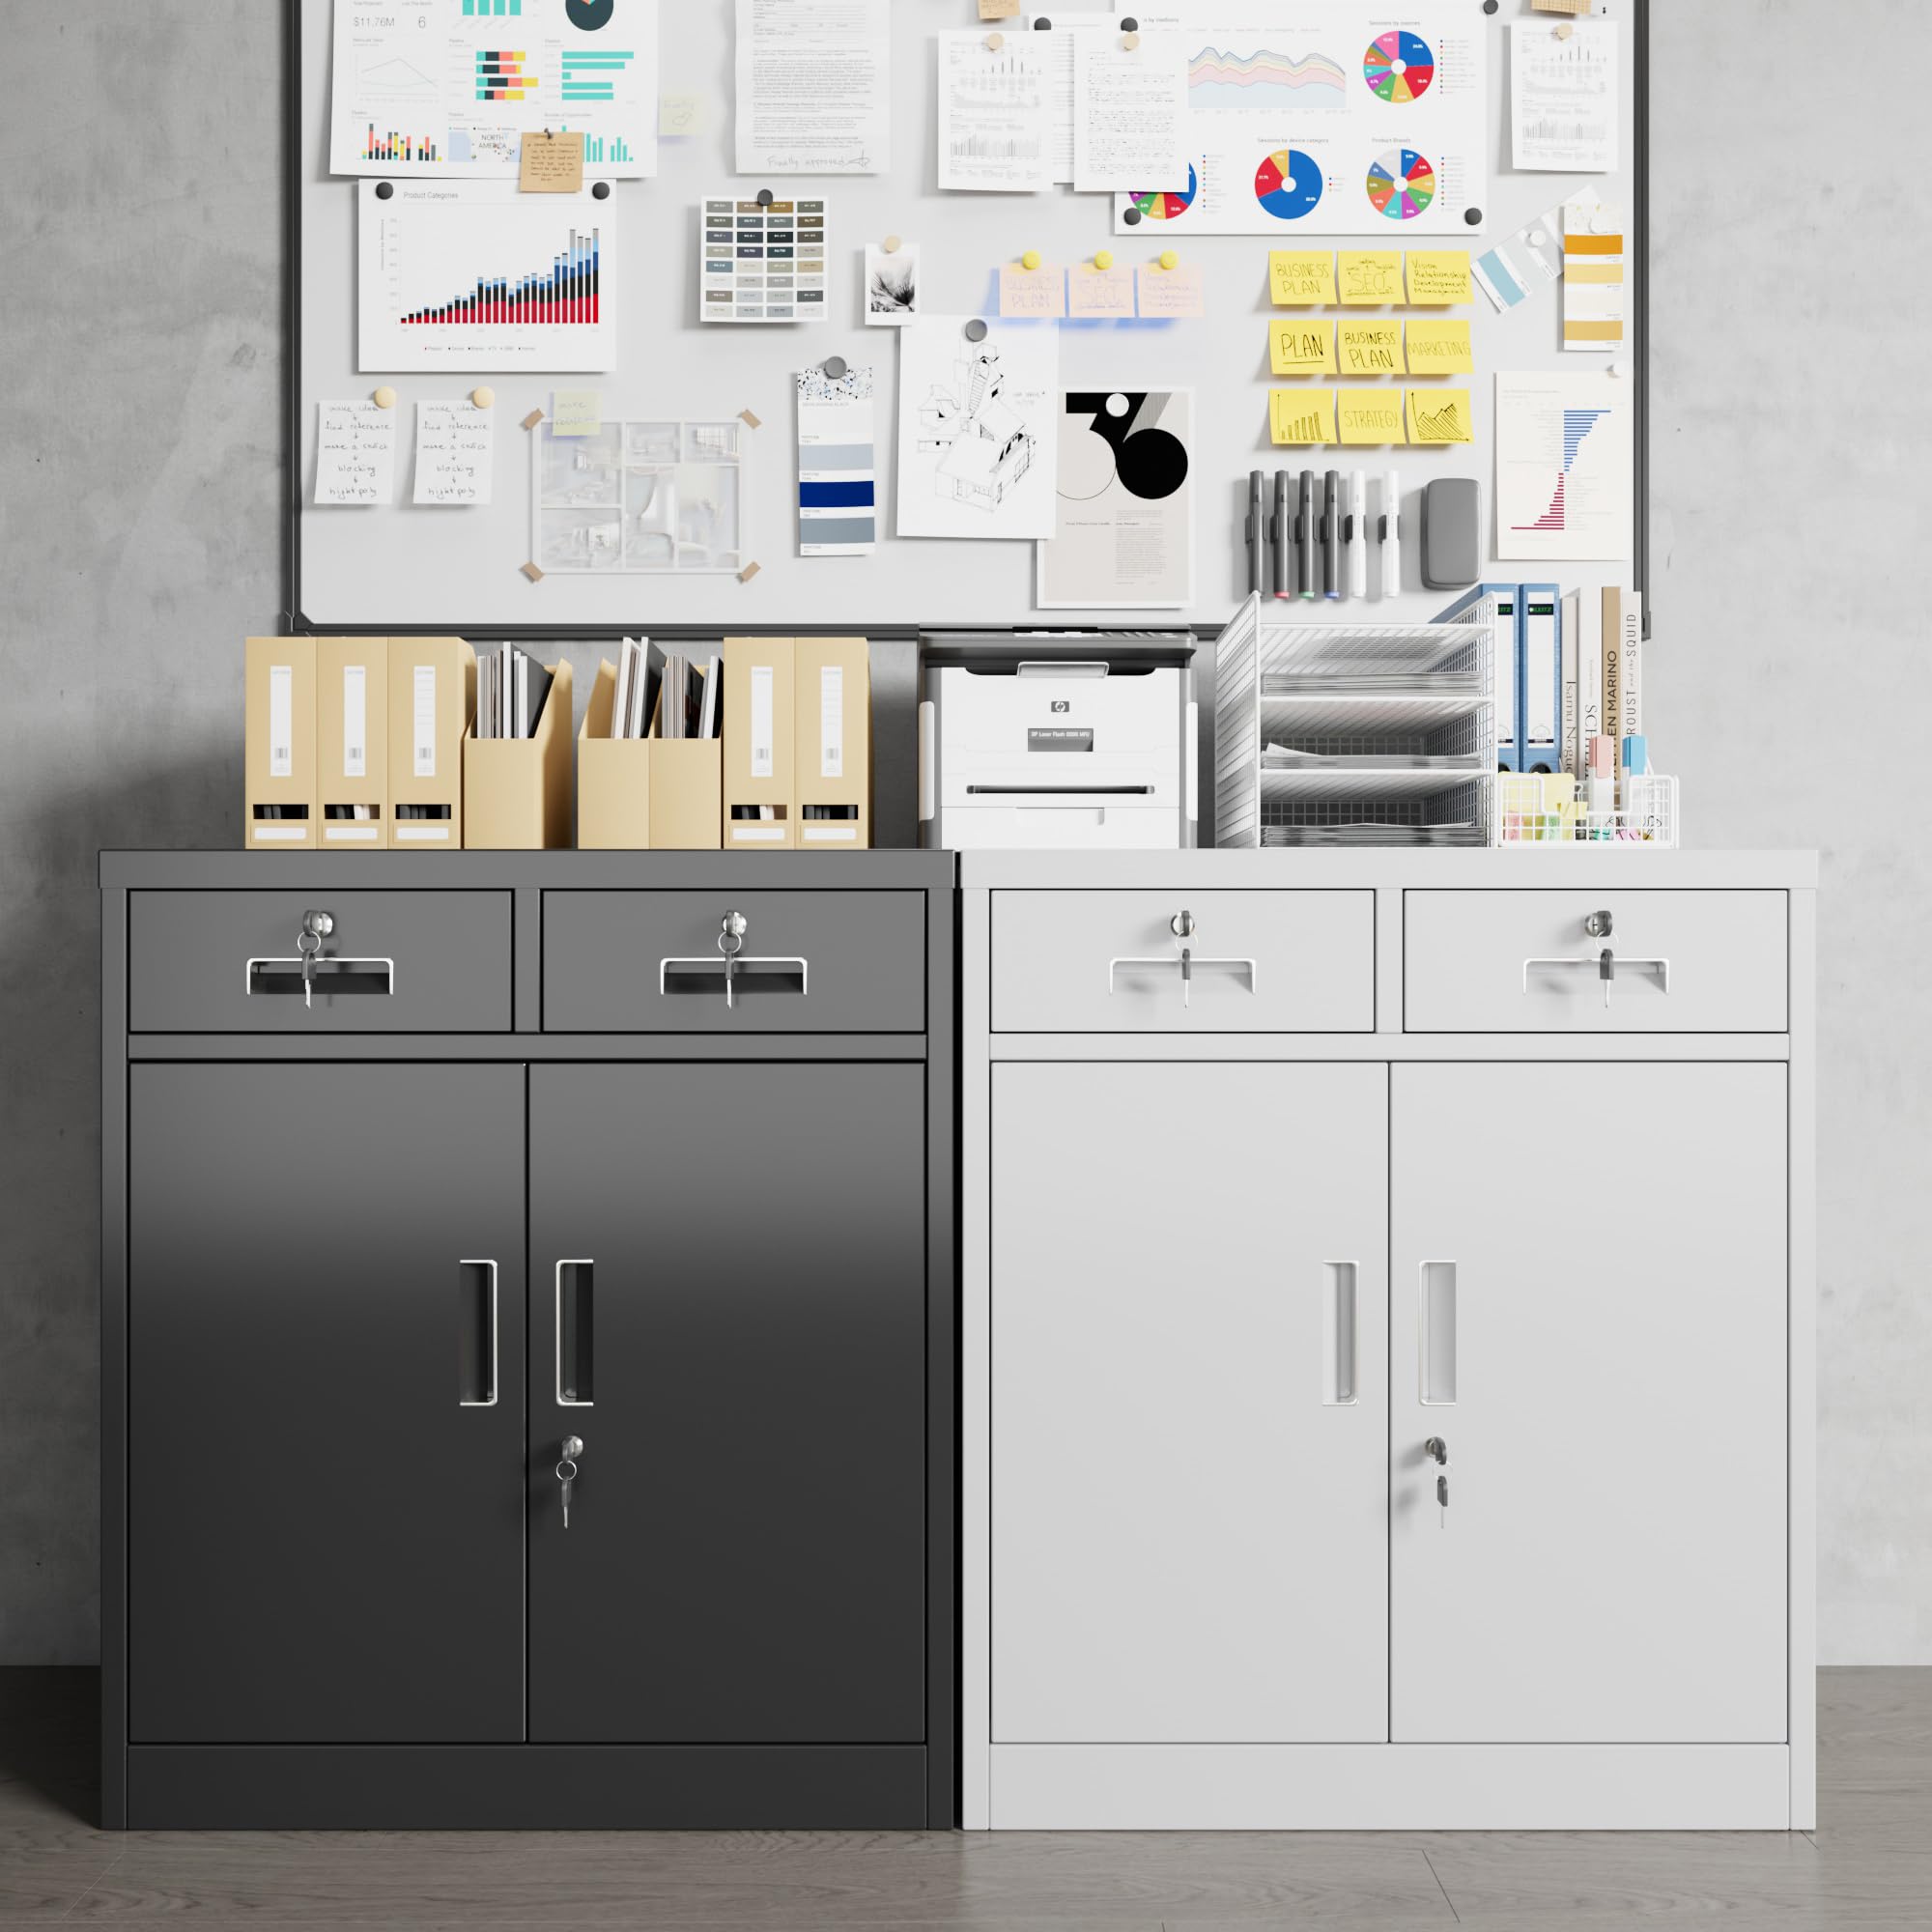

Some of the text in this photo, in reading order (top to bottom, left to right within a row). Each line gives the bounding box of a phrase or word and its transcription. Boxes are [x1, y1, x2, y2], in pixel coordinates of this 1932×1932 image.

[418, 15, 426, 28] 6
[427, 191, 459, 200] Categories
[1275, 262, 1330, 279] BUSINESS
[1282, 279, 1321, 296] PLAN
[1281, 333, 1323, 358] PLAN
[1345, 331, 1397, 346] BUSINESS
[1407, 341, 1471, 356] MARKETING
[1349, 349, 1394, 369] PLAN
[1344, 411, 1399, 429] STRATEGY
[1626, 613, 1636, 657] SQUID
[1606, 650, 1617, 711] MARINO
[1565, 681, 1577, 723] Isamu
[1626, 690, 1636, 735] ROUST
